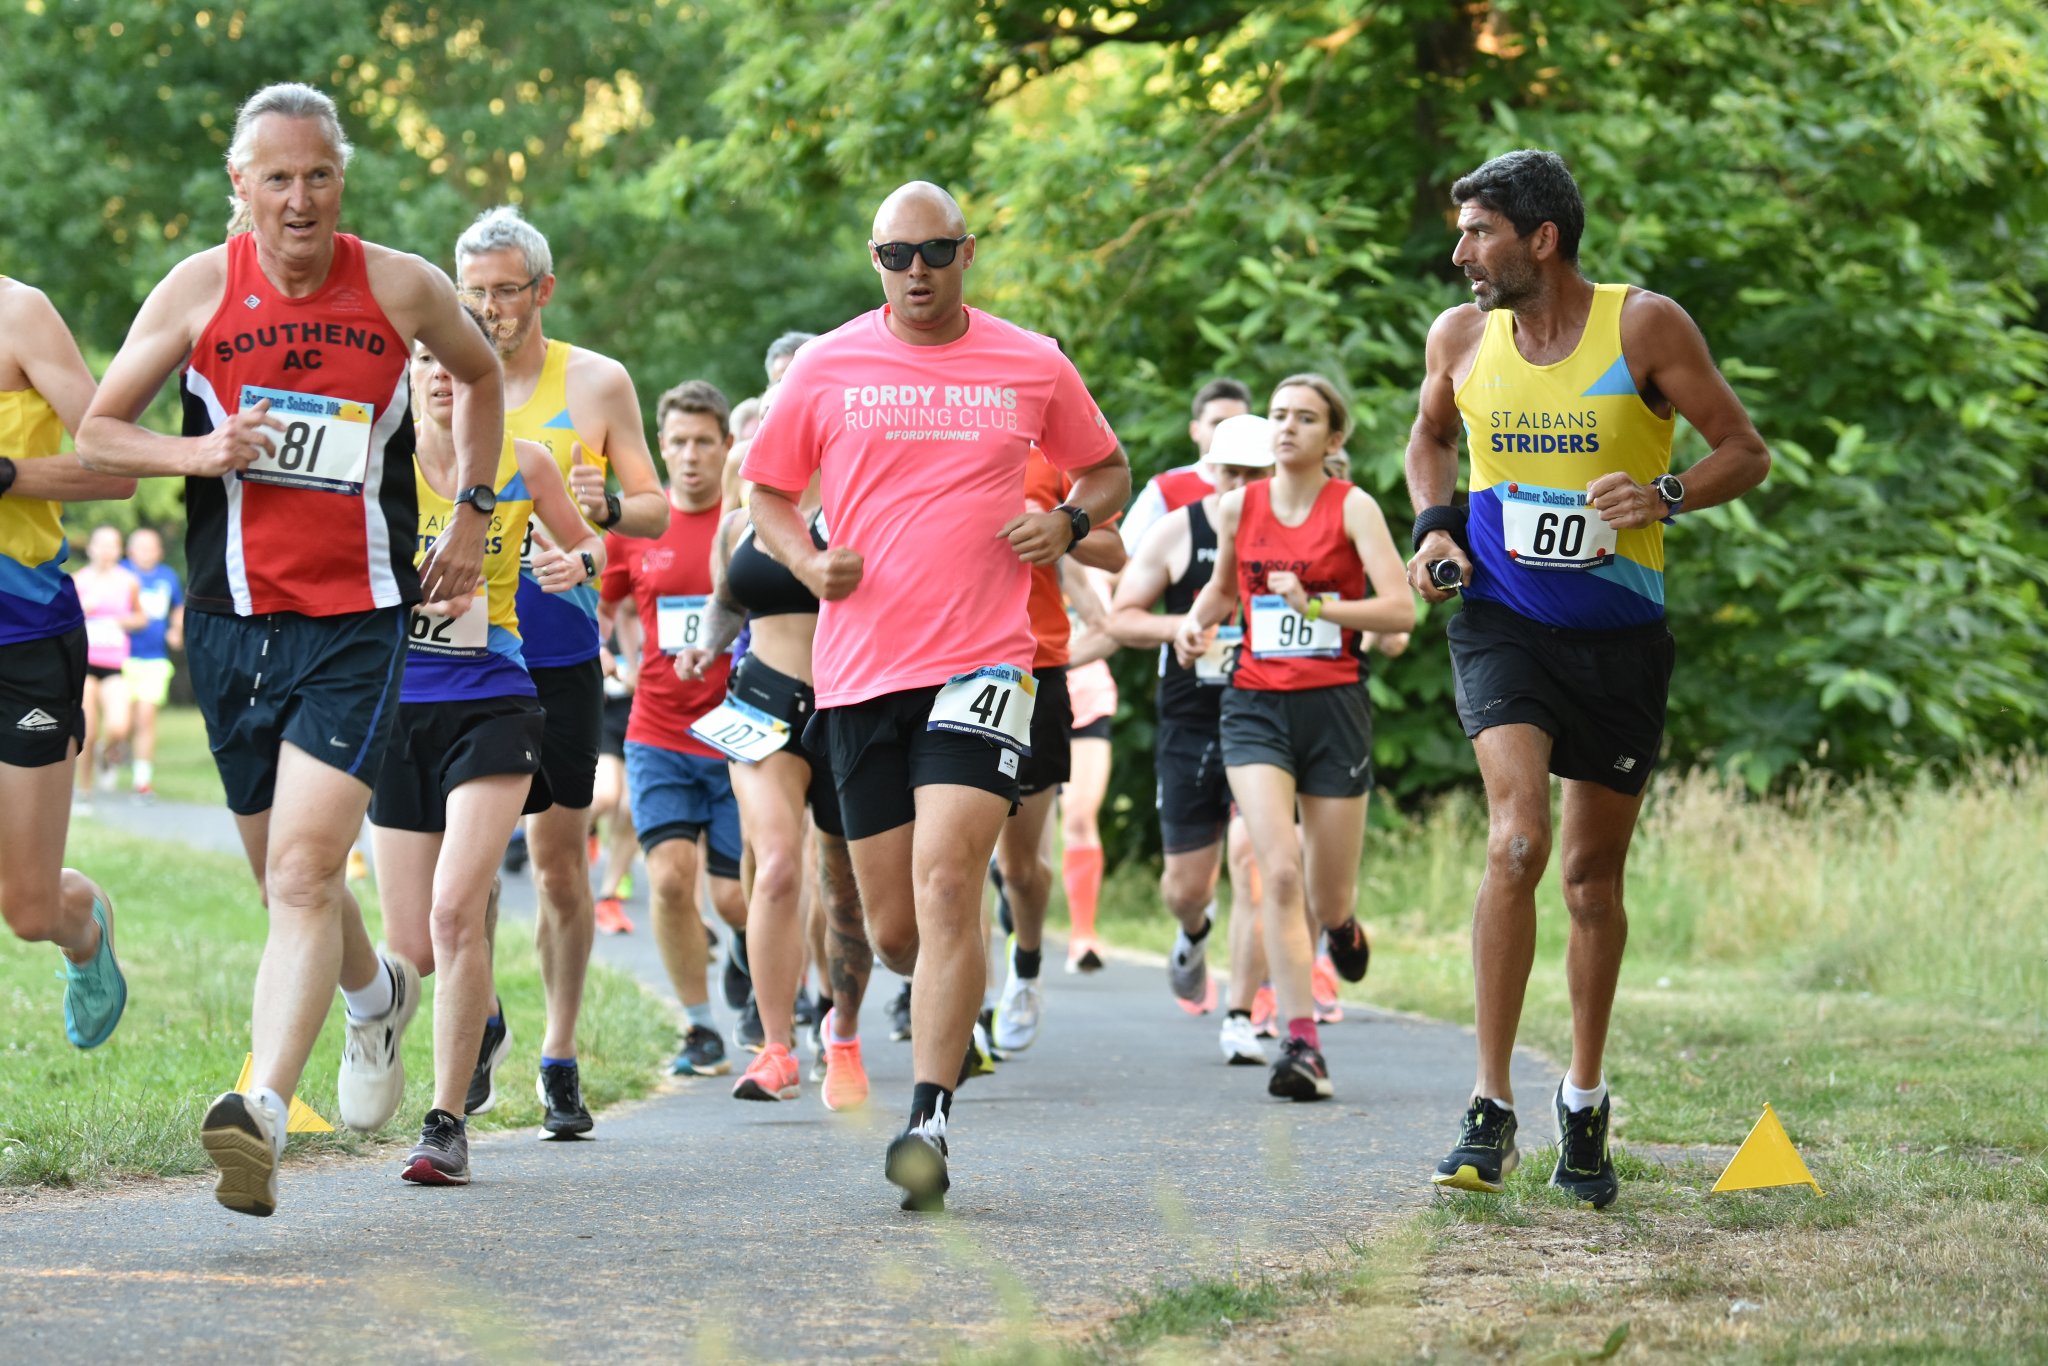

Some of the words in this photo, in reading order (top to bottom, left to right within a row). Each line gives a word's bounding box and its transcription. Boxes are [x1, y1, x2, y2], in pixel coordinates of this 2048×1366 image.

[215, 322, 386, 363] SOUTHEND
[283, 349, 322, 370] AC
[286, 396, 324, 414] Solstice
[844, 386, 936, 410] FORDY
[945, 386, 1017, 410] RUNS
[845, 408, 950, 432] RUNNING
[959, 409, 1017, 431] CLUB
[1491, 411, 1512, 428] ST
[1516, 411, 1597, 429] ALBANS
[278, 421, 326, 472] 81
[885, 430, 980, 441] #FORDYRUNNER
[1491, 433, 1600, 453] STRIDERS
[1507, 490, 1541, 504] Summer
[1542, 490, 1575, 506] Solstice
[1533, 512, 1586, 557] 60
[411, 614, 457, 643] 62
[1279, 615, 1313, 647] 96
[969, 684, 1011, 728] 41
[711, 722, 768, 749] 107
